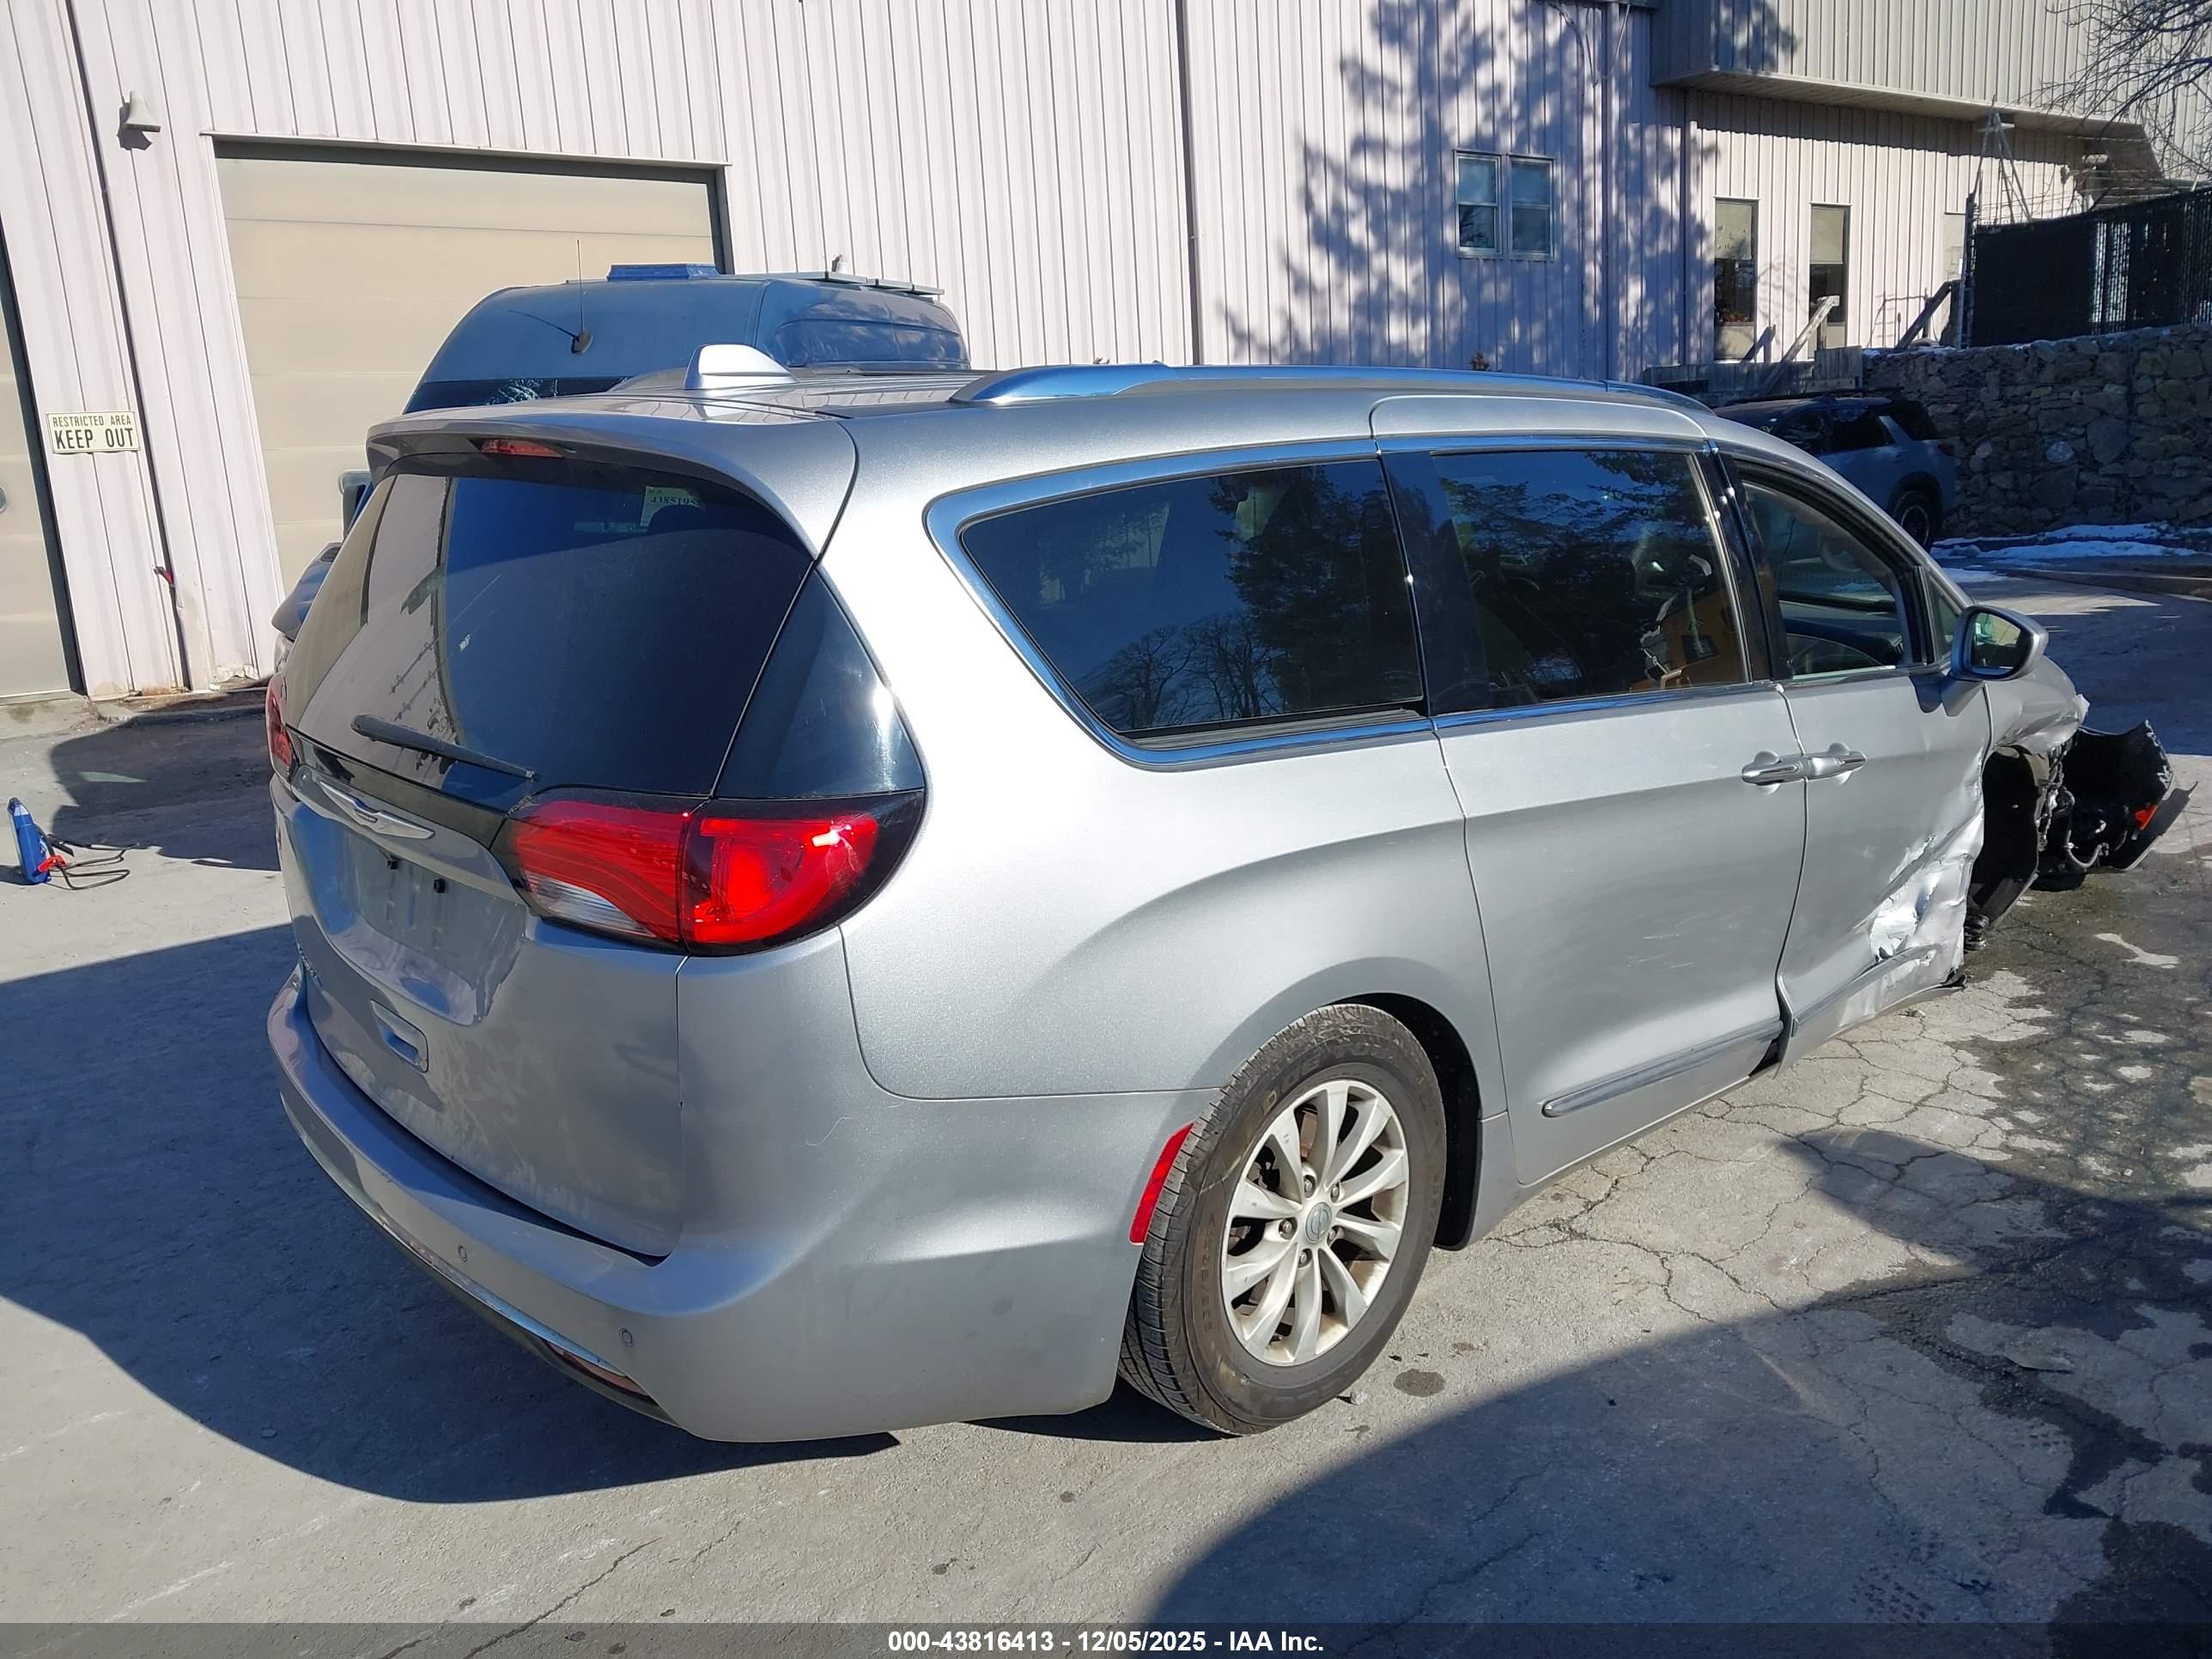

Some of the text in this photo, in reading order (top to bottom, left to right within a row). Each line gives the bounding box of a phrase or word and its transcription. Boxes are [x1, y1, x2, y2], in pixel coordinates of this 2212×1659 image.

[52, 415, 132, 428] RESTRICTED AREA
[54, 428, 134, 450] KEEP OUT
